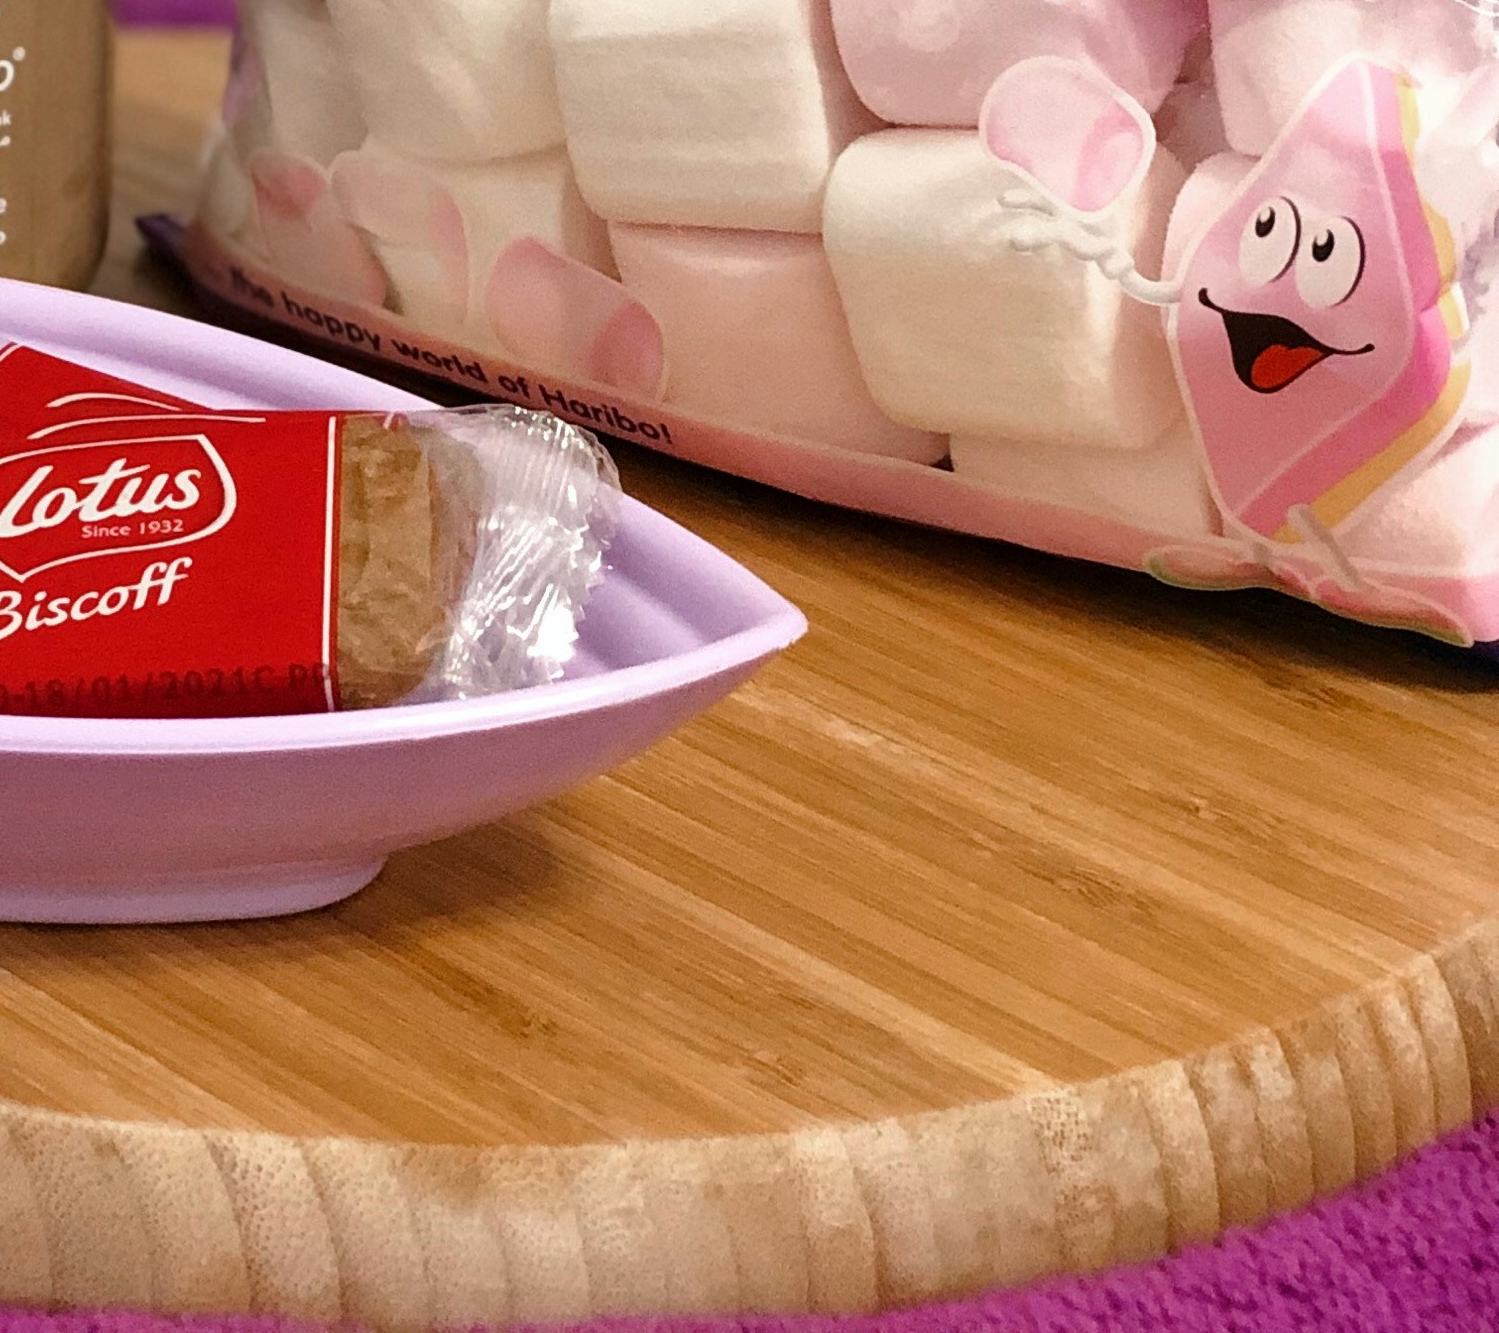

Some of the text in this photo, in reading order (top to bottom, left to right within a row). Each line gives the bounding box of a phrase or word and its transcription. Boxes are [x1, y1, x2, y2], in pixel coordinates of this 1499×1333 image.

[230, 267, 672, 445] the happy world of Haribo!
[81, 518, 184, 539] Since 1932
